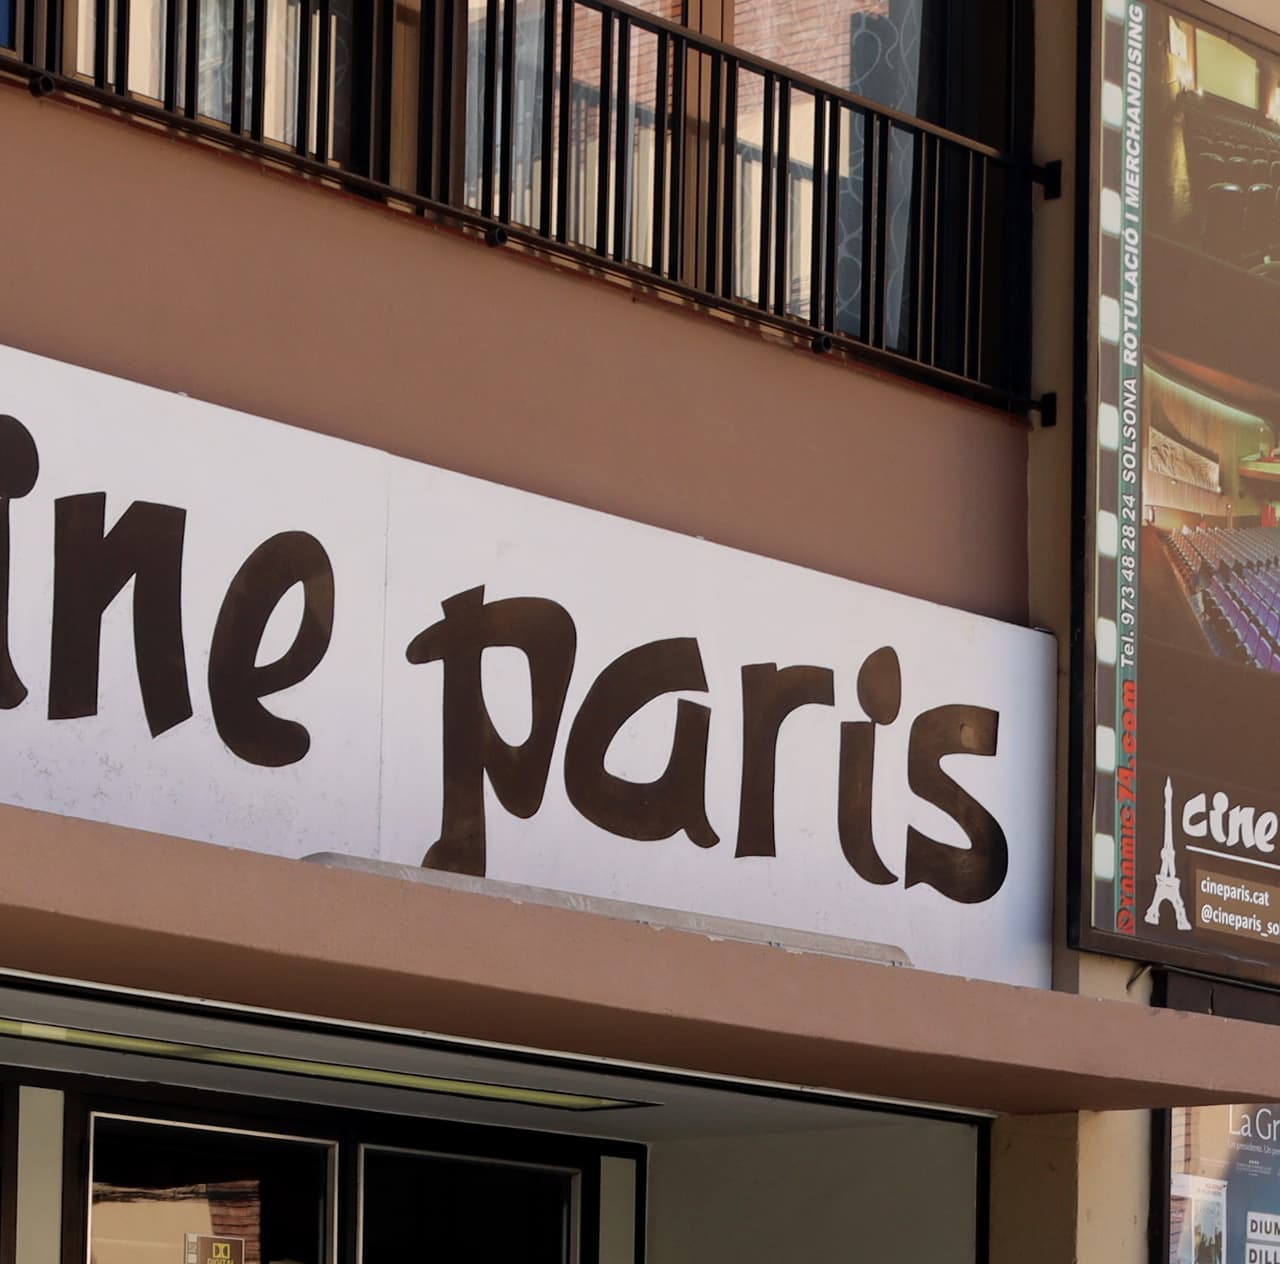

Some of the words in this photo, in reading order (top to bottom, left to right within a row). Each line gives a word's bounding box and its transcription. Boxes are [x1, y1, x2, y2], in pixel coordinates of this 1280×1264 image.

[1125, 4, 1145, 208] MERCHANDISING
[1124, 226, 1139, 366] ROTULACIÓ
[1121, 377, 1138, 483] SOLSONA
[1122, 493, 1137, 519] 24
[1122, 524, 1137, 552] 28
[1122, 556, 1137, 580] 48
[1121, 579, 1136, 623] 973
[1120, 631, 1135, 667] Tel.
[405, 584, 1010, 905] paris
[1182, 792, 1278, 853] cine
[1201, 876, 1270, 907] cineparis.cat
[1229, 1104, 1252, 1138] La
